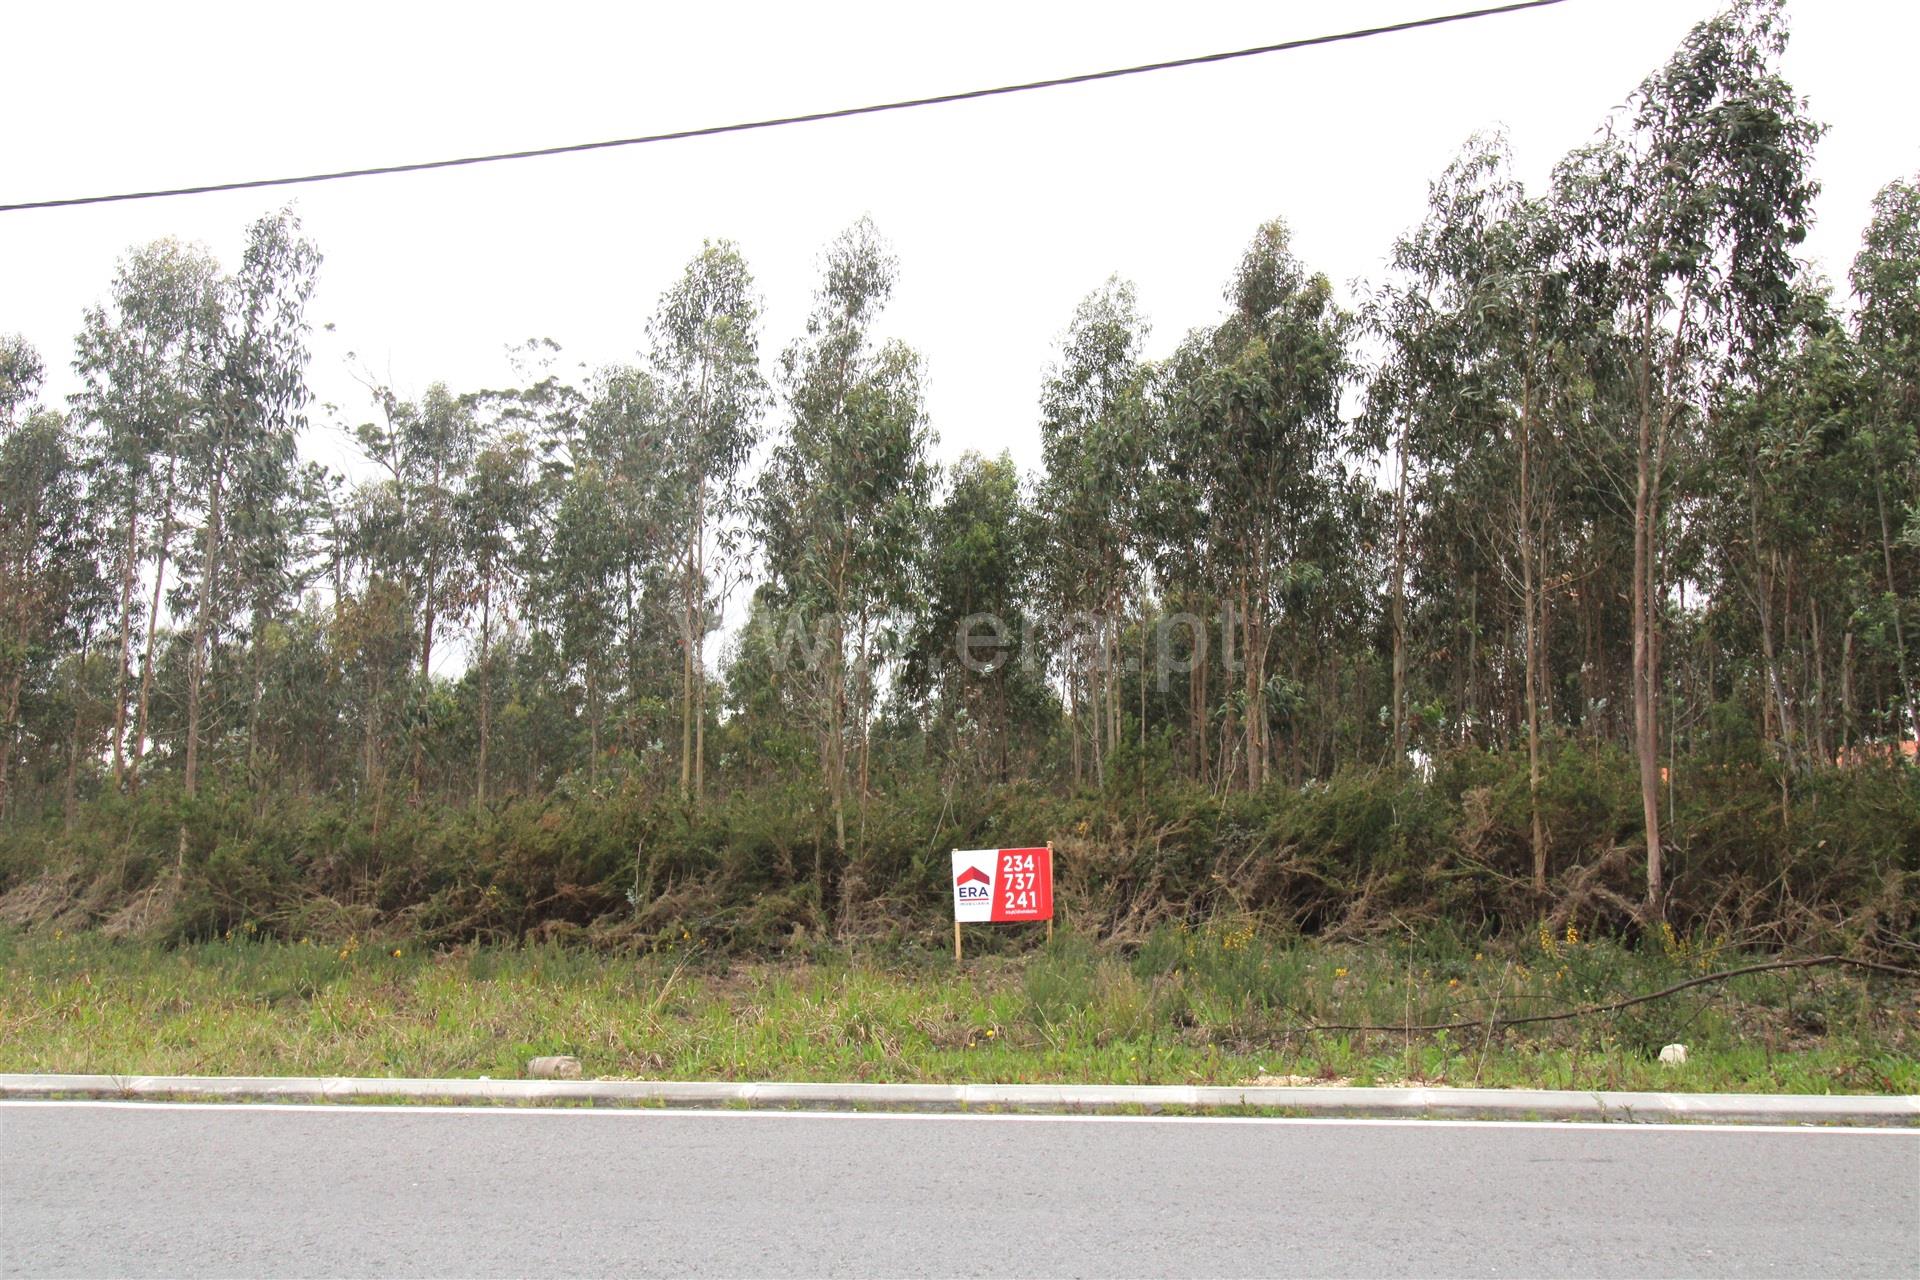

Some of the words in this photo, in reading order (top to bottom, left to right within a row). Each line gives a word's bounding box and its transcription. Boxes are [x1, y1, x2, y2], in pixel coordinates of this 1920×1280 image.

[1003, 855, 1034, 872] 234
[1004, 873, 1035, 890] 737
[959, 887, 989, 898] ERA
[1005, 891, 1036, 909] 241
